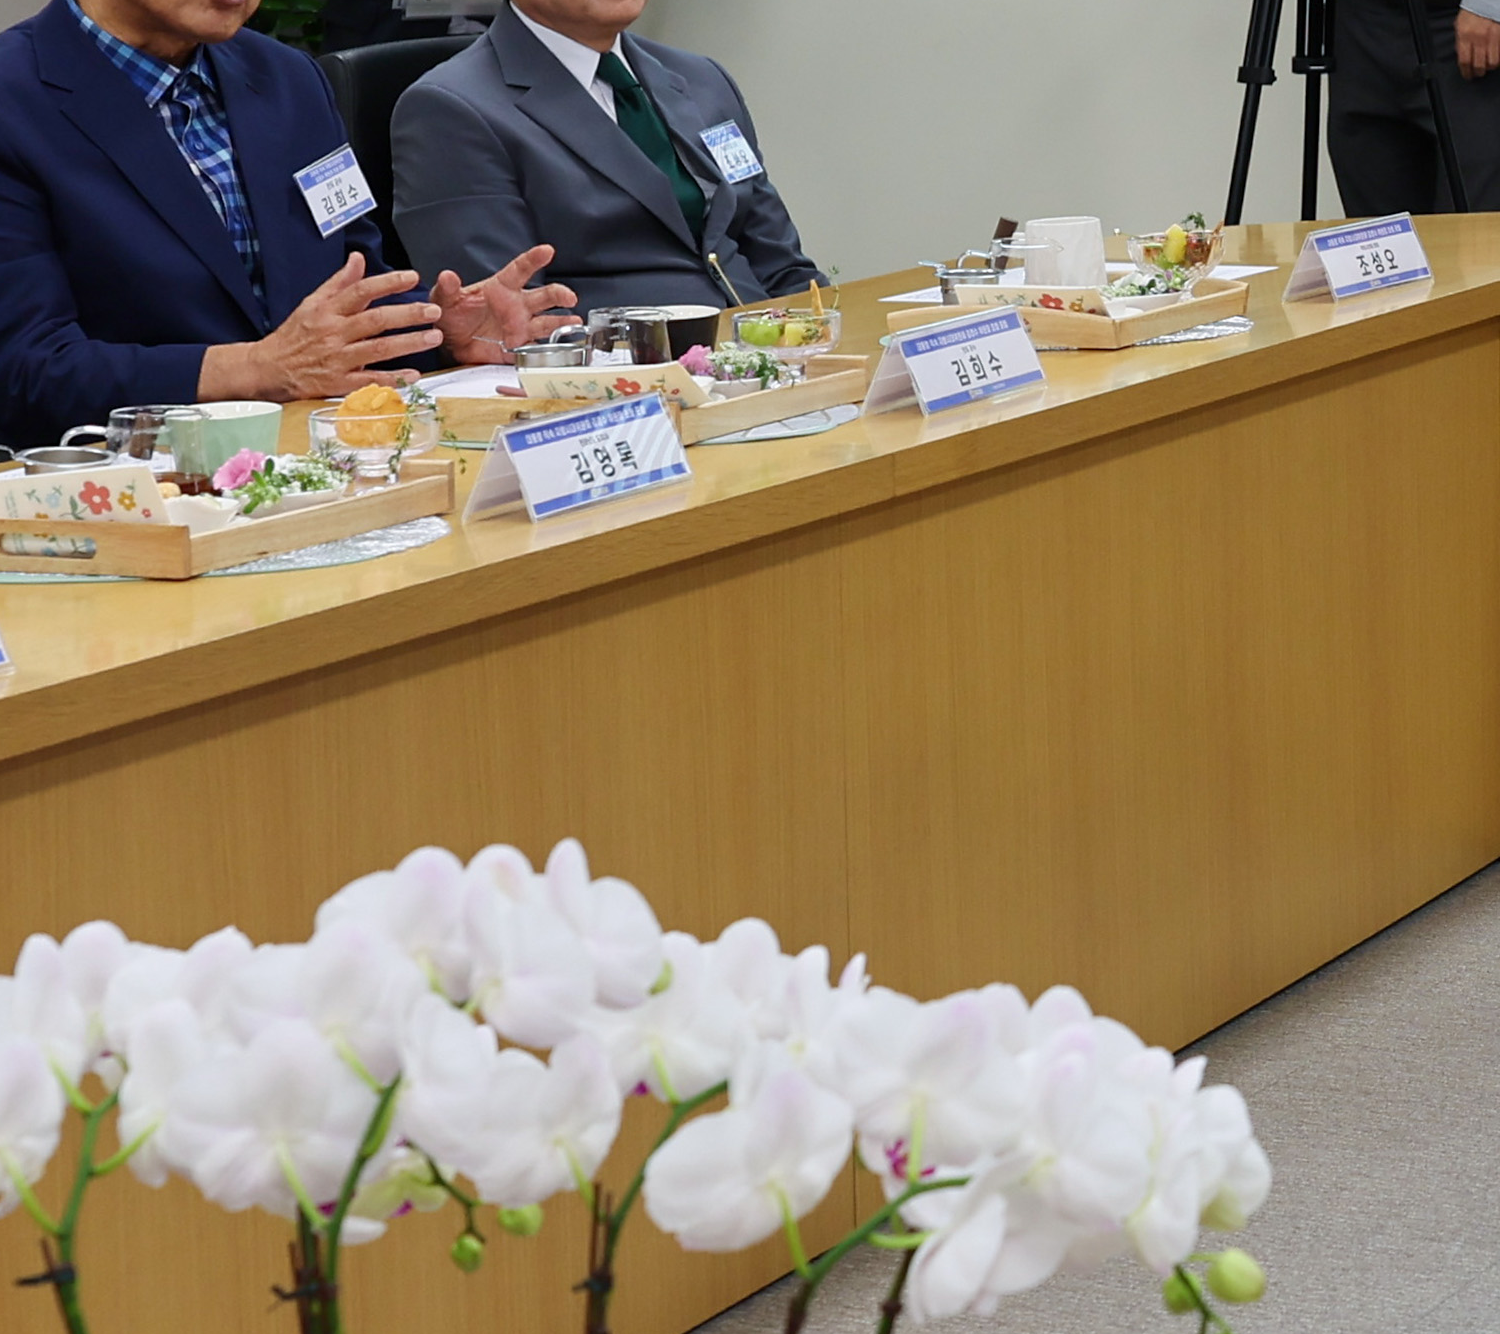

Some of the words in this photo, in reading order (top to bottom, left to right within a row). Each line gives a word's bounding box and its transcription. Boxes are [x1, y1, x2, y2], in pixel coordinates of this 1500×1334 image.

[321, 183, 359, 215] 김희수
[1356, 248, 1399, 277] 조성오
[950, 350, 1005, 387] 김희수
[570, 440, 638, 484] 김영록
